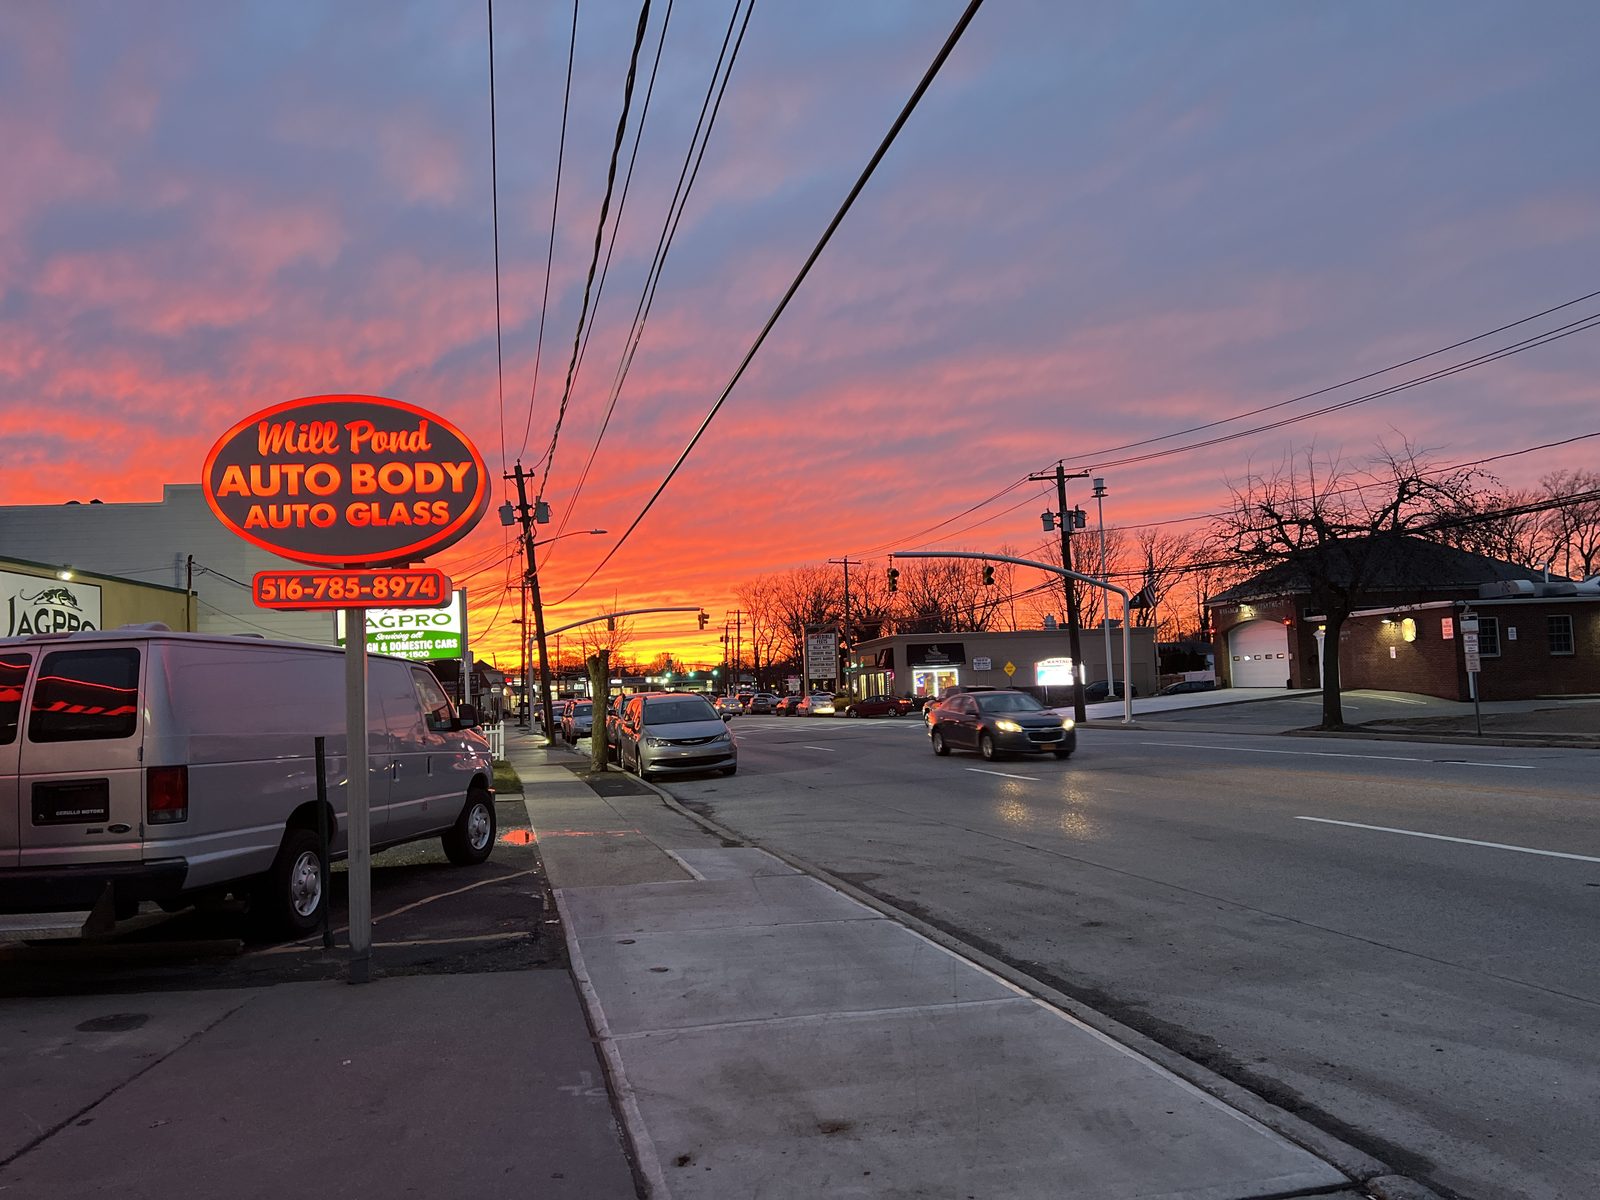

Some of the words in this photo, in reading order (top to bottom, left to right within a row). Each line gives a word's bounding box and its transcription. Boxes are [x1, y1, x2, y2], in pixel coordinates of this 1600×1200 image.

[258, 420, 340, 457] Mill
[344, 419, 432, 454] Pond
[217, 464, 342, 497] AUTO
[351, 461, 473, 495] BODY
[244, 503, 337, 529] AUTO
[345, 501, 450, 527] GLASS
[261, 575, 437, 600] 516-785-8974
[366, 613, 452, 628] AGPRO
[375, 632, 409, 642] Servicing
[410, 631, 424, 639] all
[381, 643, 387, 651] &
[390, 640, 433, 651] DOMESTIC
[435, 639, 458, 649] CARS
